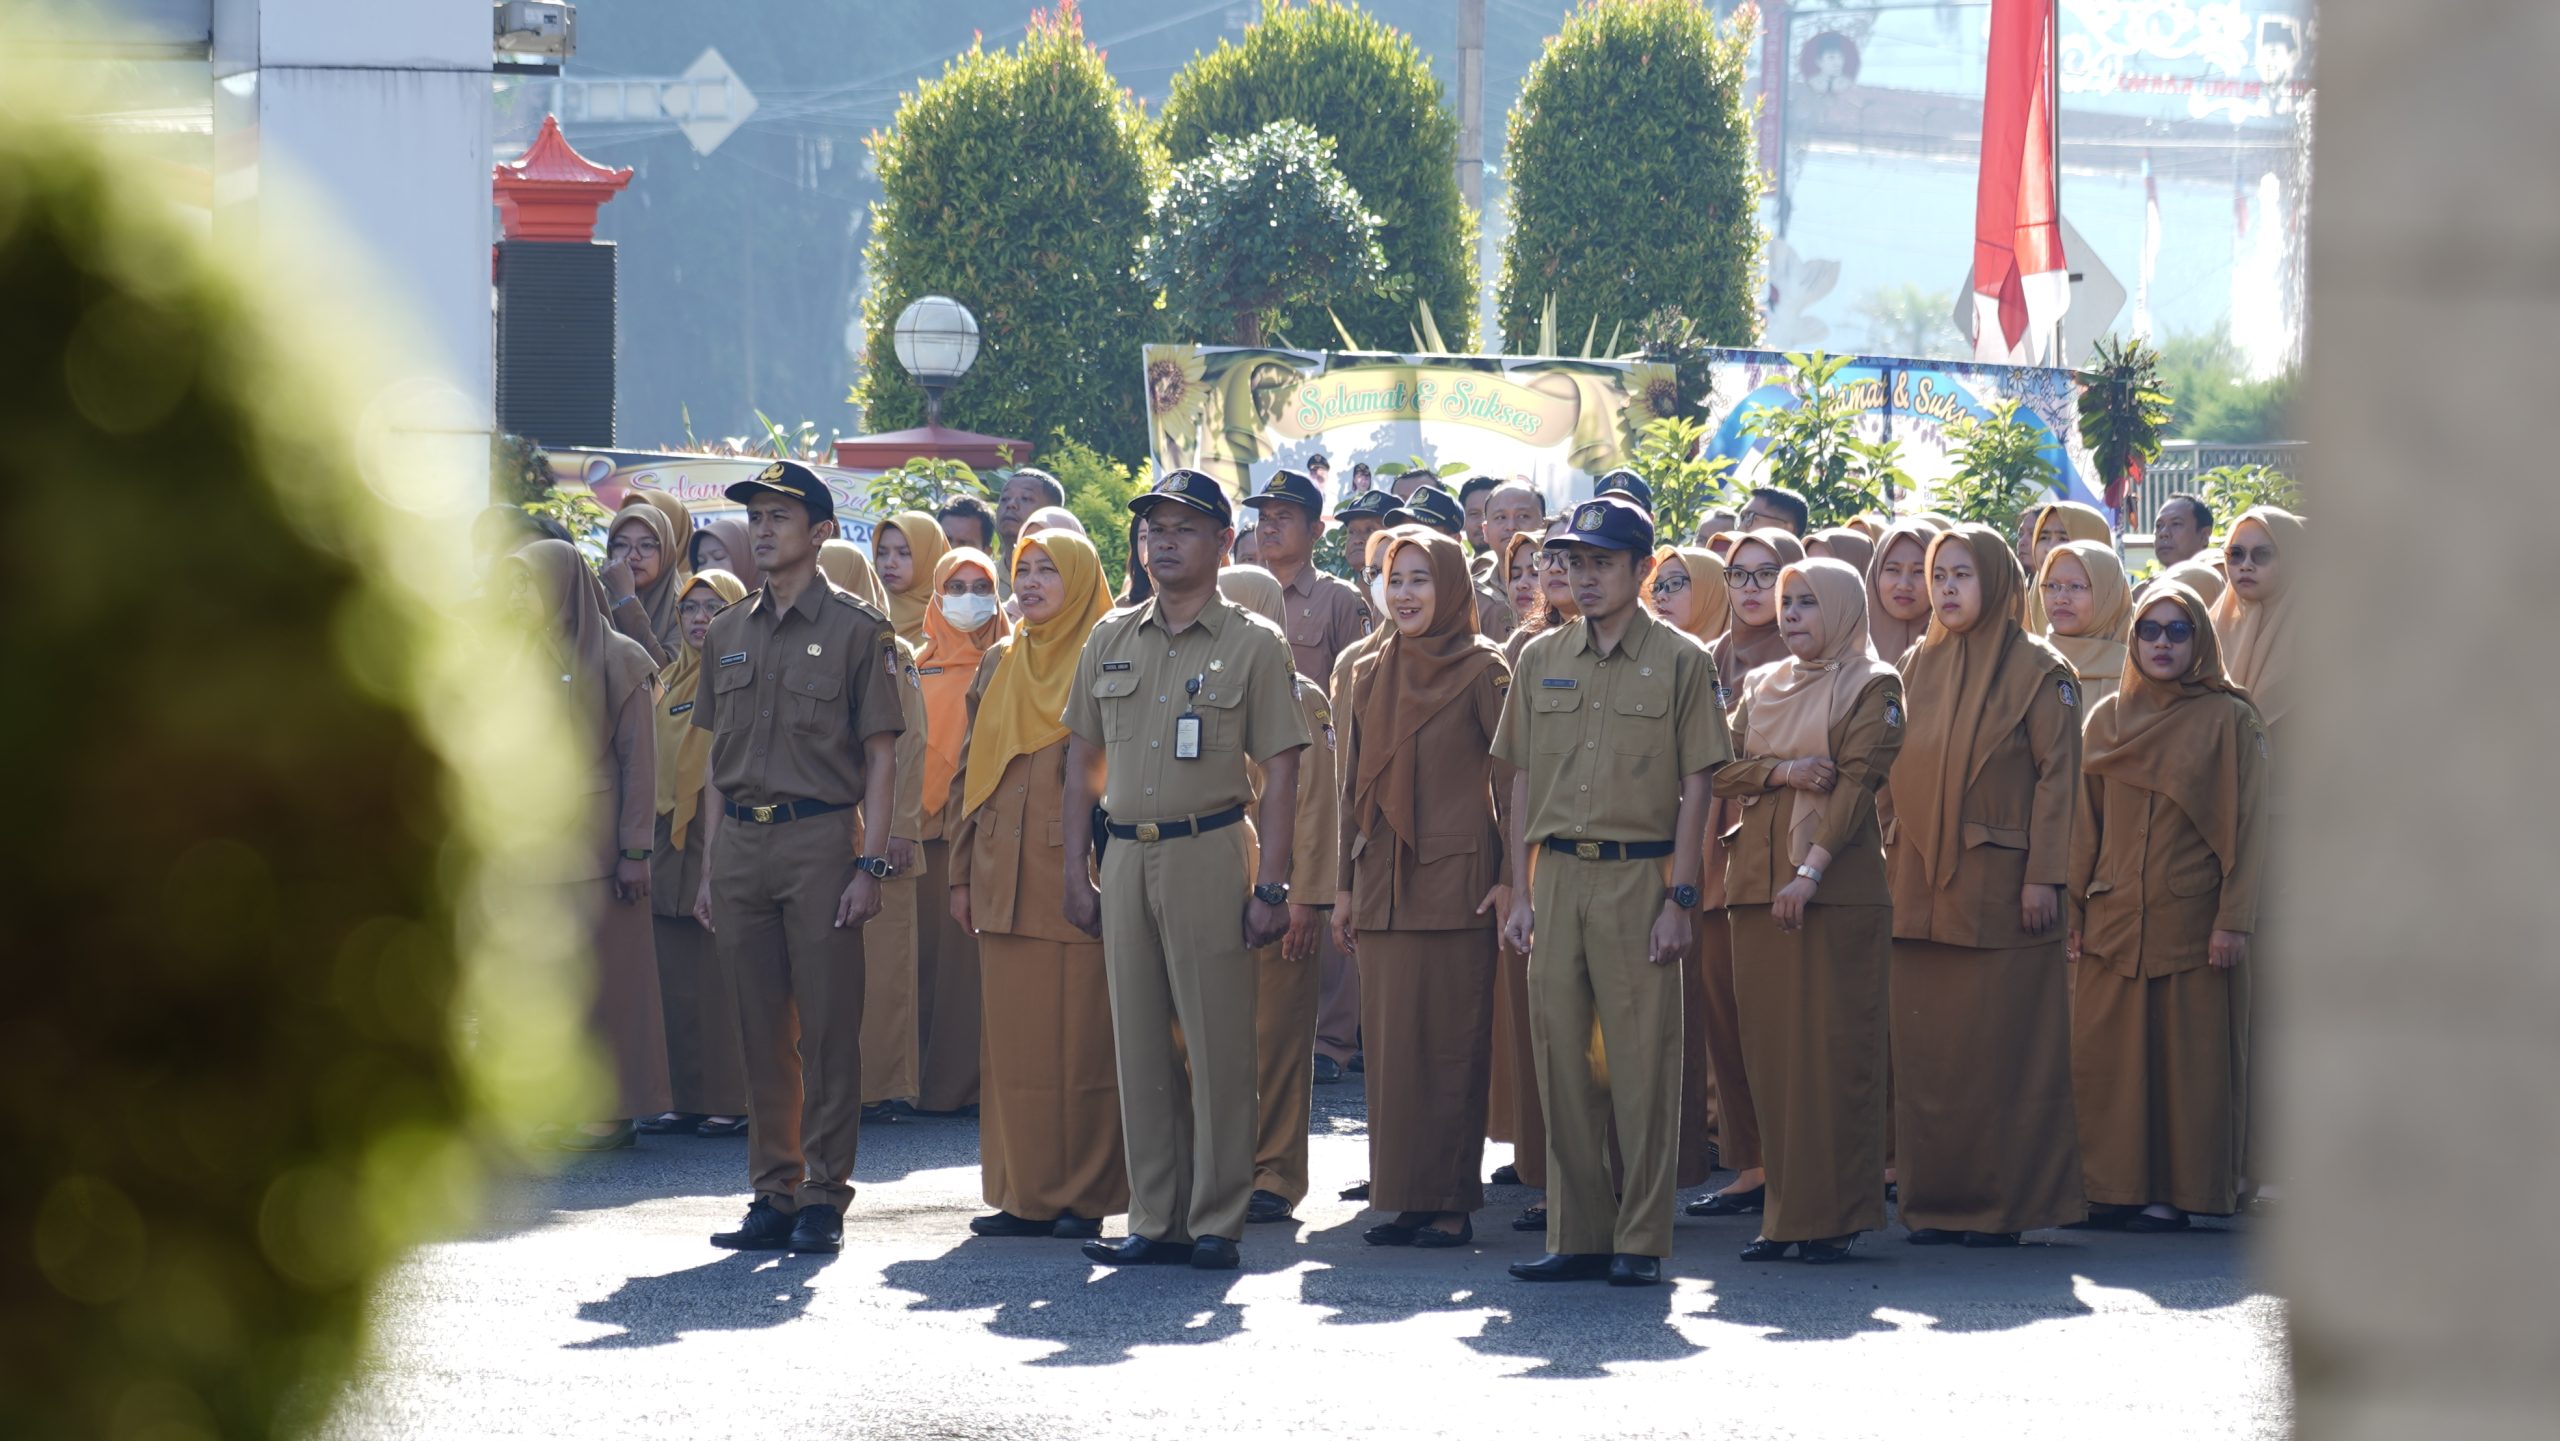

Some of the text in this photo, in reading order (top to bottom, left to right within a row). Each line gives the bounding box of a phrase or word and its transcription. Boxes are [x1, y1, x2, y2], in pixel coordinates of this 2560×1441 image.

[1298, 378, 1542, 434] Selamat & Sukses
[1893, 371, 1911, 410] &
[1914, 376, 1974, 426] Suks
